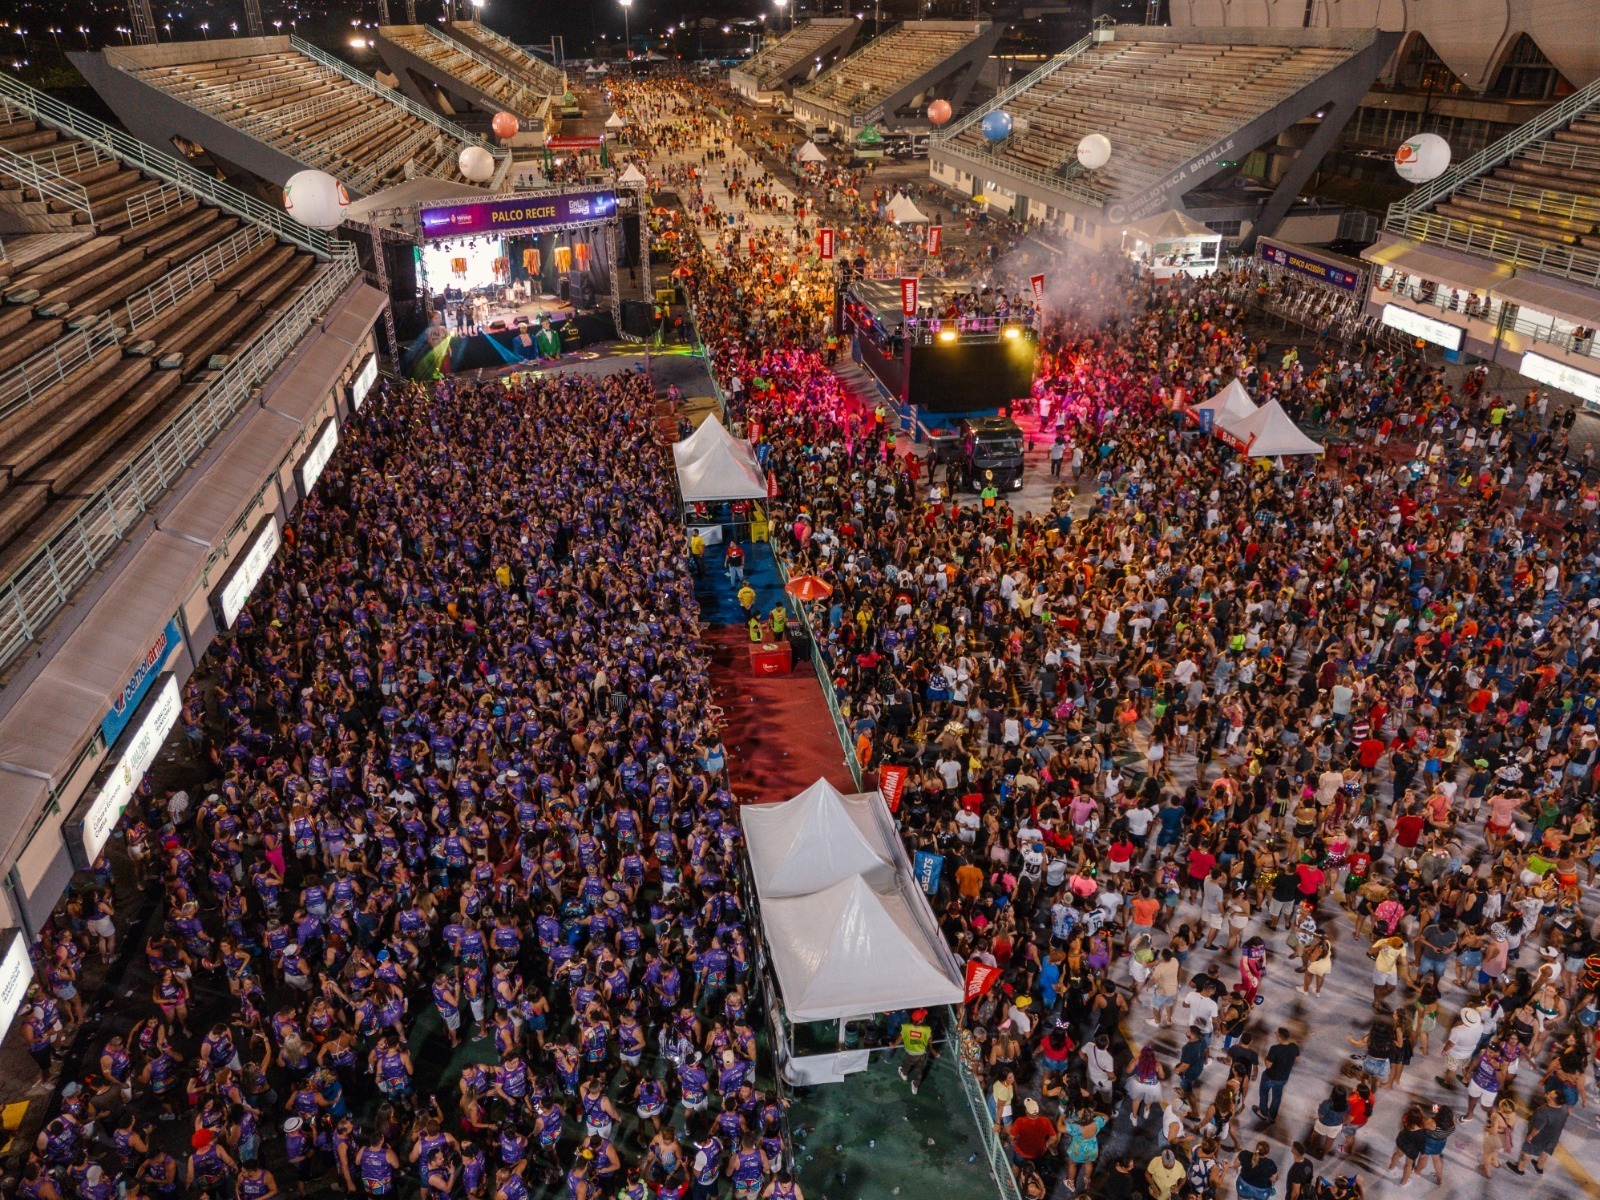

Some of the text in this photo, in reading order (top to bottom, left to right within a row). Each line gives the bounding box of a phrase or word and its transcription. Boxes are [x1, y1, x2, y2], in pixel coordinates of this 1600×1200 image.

[528, 119, 540, 131] F
[1127, 139, 1235, 213] BIBLIOTECA BRAILLE
[491, 206, 556, 223] PALCO RECIFE
[1288, 256, 1305, 269] ESPAÇO
[905, 282, 914, 312] BRAHMA
[1221, 431, 1237, 448] BAR
[921, 857, 934, 892] BEATS
[968, 966, 992, 997] BRAHMA
